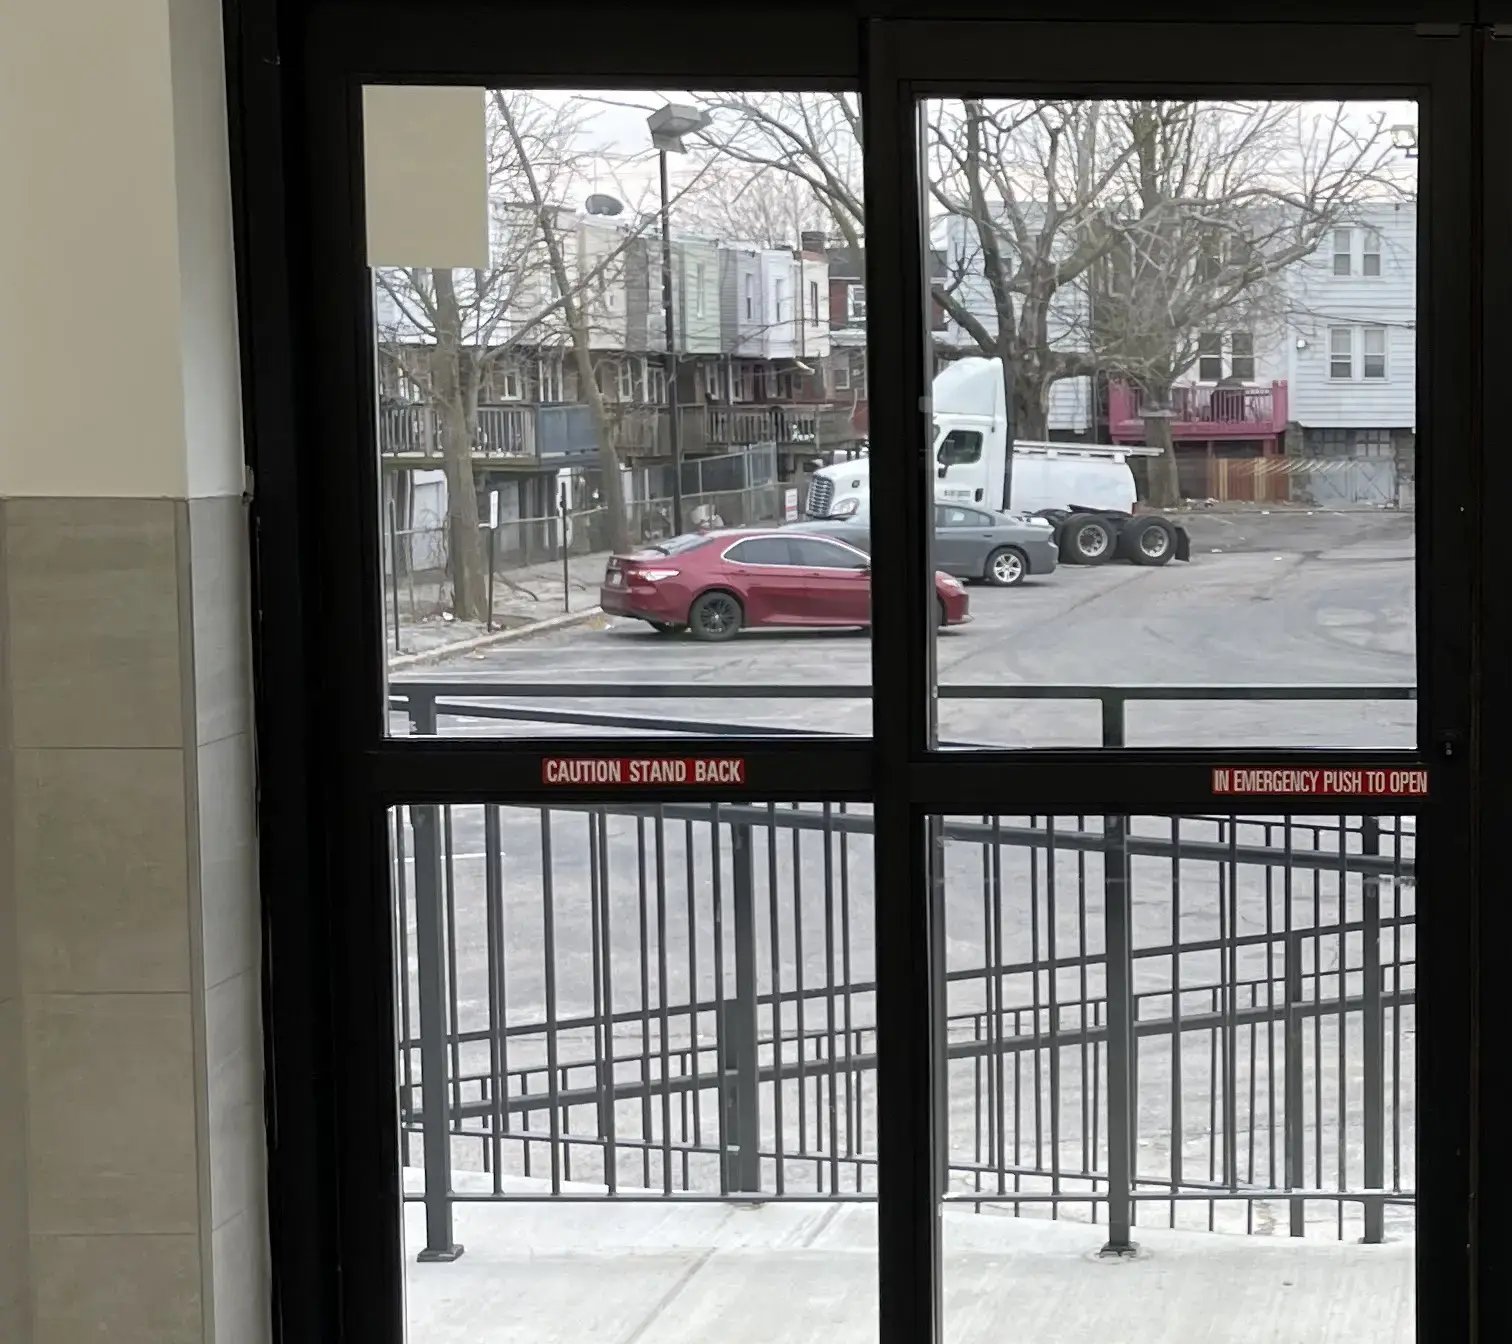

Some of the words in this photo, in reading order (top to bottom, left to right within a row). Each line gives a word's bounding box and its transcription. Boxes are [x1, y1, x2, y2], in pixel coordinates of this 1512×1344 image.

[547, 760, 622, 782] CAUTION
[629, 760, 687, 783] STAND
[694, 761, 742, 783] BACK
[1214, 769, 1230, 792] IN
[1233, 769, 1319, 793] EMERGENCY
[1323, 770, 1362, 793] PUSH
[1366, 771, 1386, 793] TO
[1390, 771, 1428, 793] OPEN
